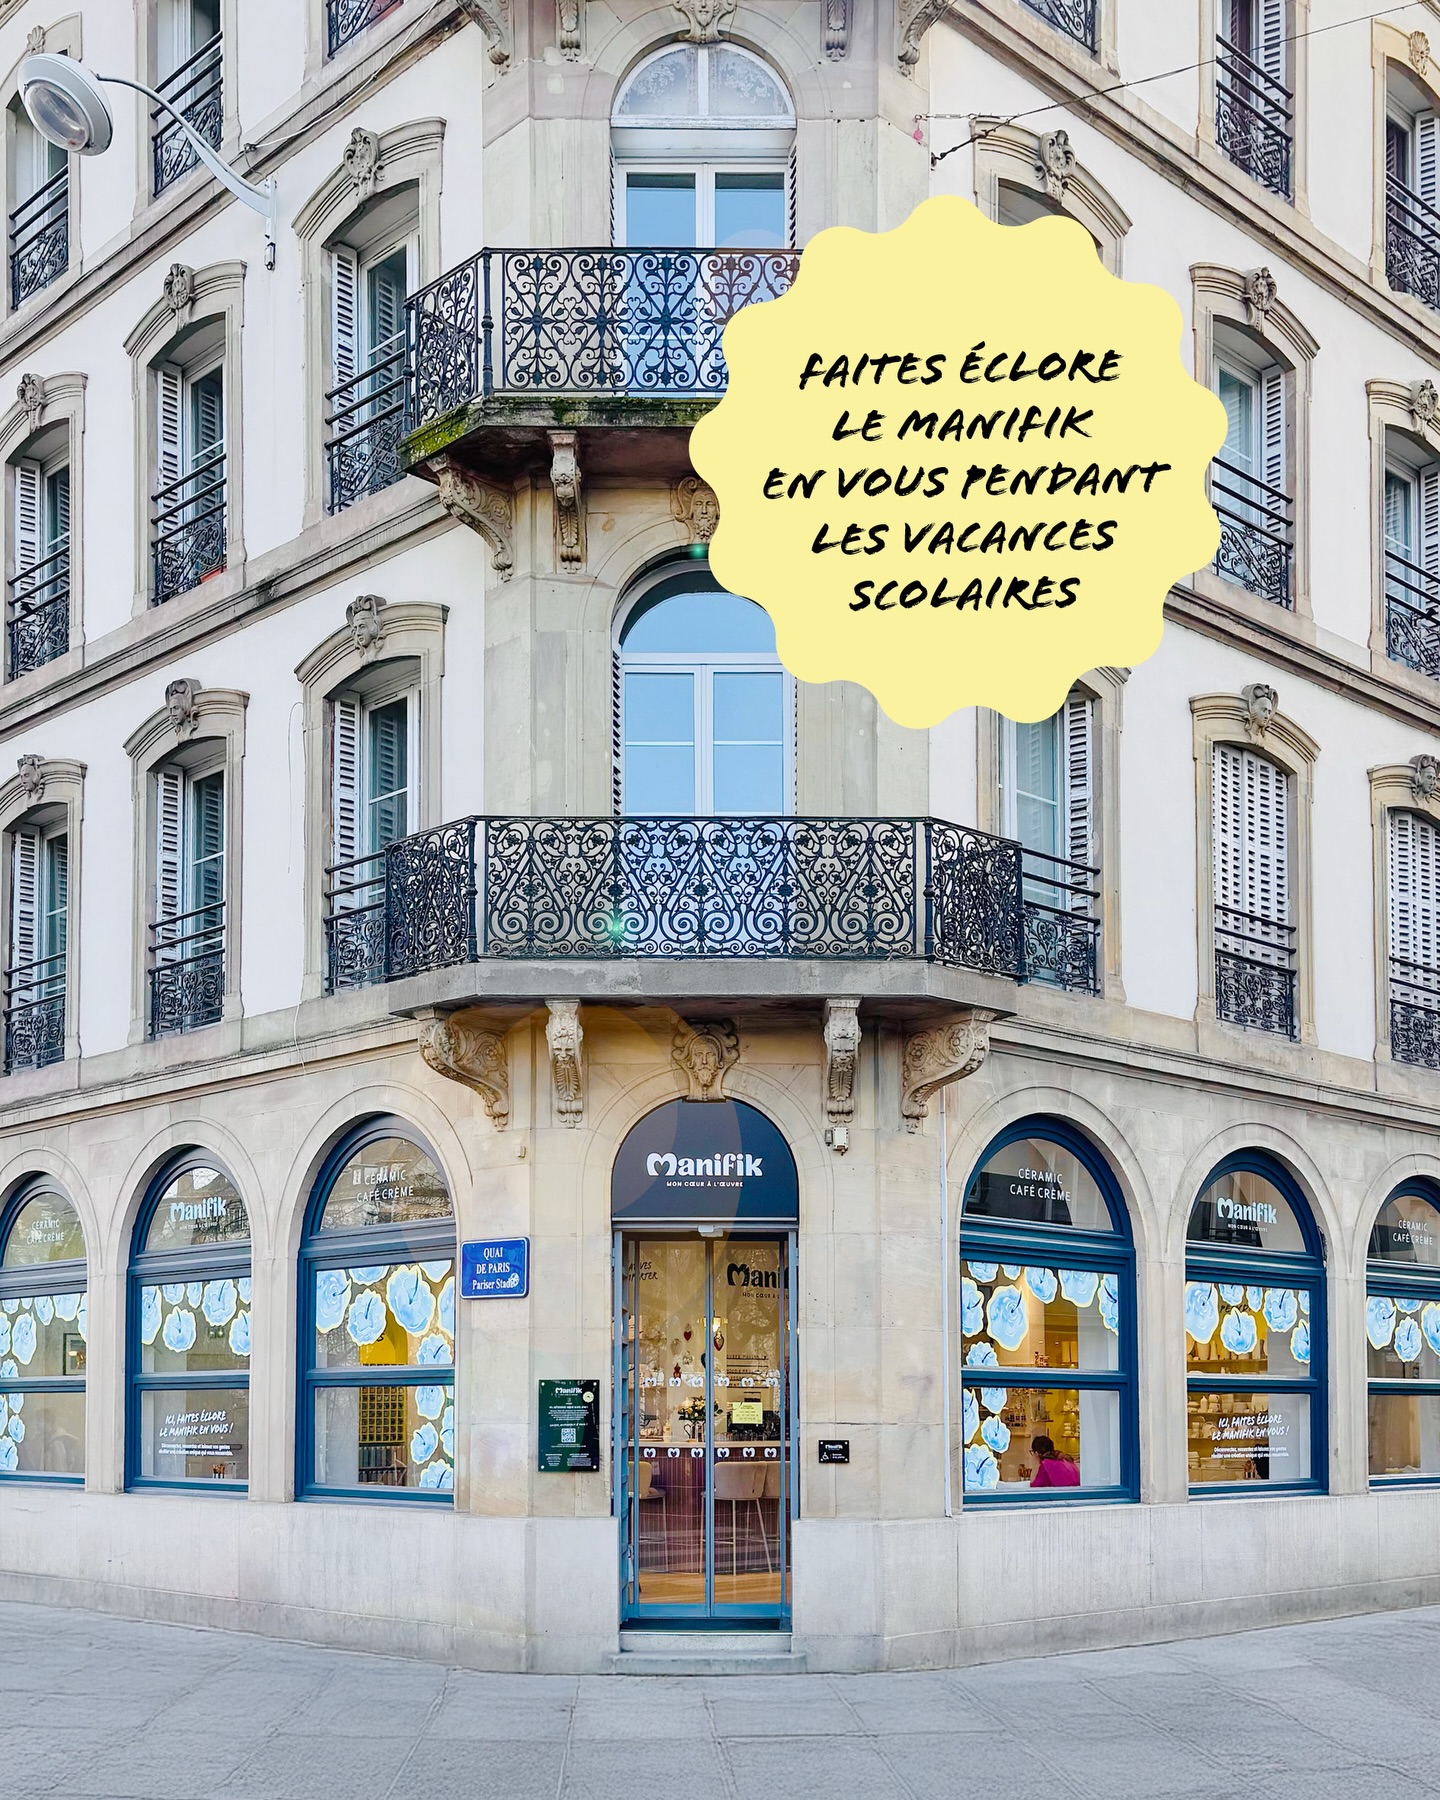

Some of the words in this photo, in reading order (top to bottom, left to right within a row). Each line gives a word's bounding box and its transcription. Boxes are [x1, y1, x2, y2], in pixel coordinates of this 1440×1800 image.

[647, 1152, 763, 1177] Manifik
[1018, 1167, 1063, 1184] CÉRAMIC
[357, 1187, 381, 1202] CAFÉ
[381, 1185, 414, 1200] CRÈME
[1010, 1184, 1036, 1197] CAFÉ
[1037, 1187, 1071, 1202] CRÈME
[170, 1196, 227, 1222] Manifik
[1217, 1197, 1278, 1224] Manifik
[483, 1246, 504, 1261] QUAI
[476, 1263, 487, 1275] DE
[488, 1261, 511, 1274] PARIS
[472, 1279, 496, 1290] Pariser
[176, 1411, 200, 1425] FAITES
[1231, 1415, 1256, 1427] FAITES
[159, 1427, 168, 1438] LE
[199, 1424, 210, 1435] EN
[1211, 1430, 1222, 1441] LE
[1255, 1428, 1267, 1438] EN
